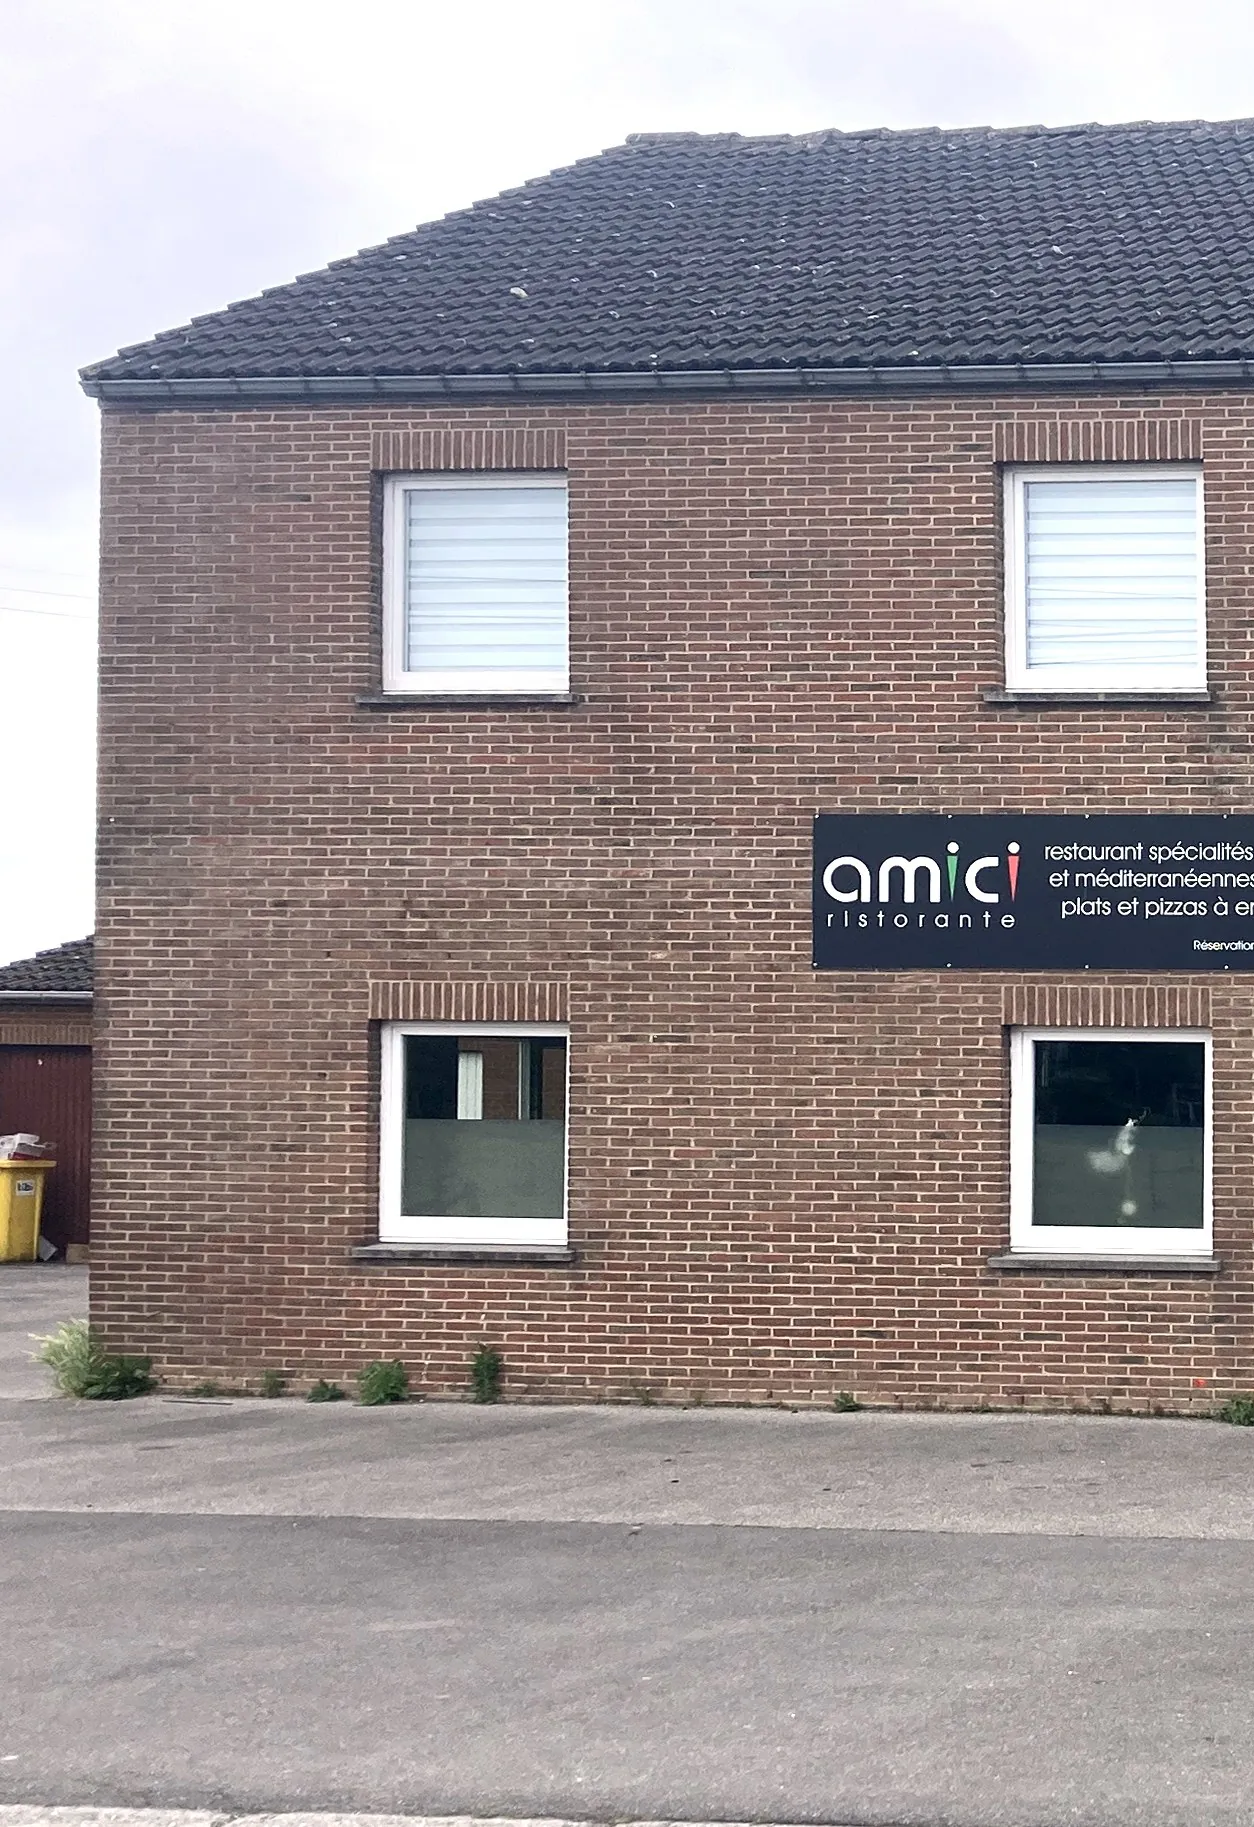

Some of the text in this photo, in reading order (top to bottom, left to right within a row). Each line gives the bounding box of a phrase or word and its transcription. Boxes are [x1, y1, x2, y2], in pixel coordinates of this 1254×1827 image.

[1044, 842, 1144, 861] restaurant
[1148, 840, 1254, 865] spécialités
[823, 842, 1020, 903] amici
[1048, 869, 1071, 888] et
[1061, 897, 1112, 919] plats
[1117, 898, 1140, 916] et
[1144, 898, 1208, 920] pizzas
[1213, 896, 1229, 916] à
